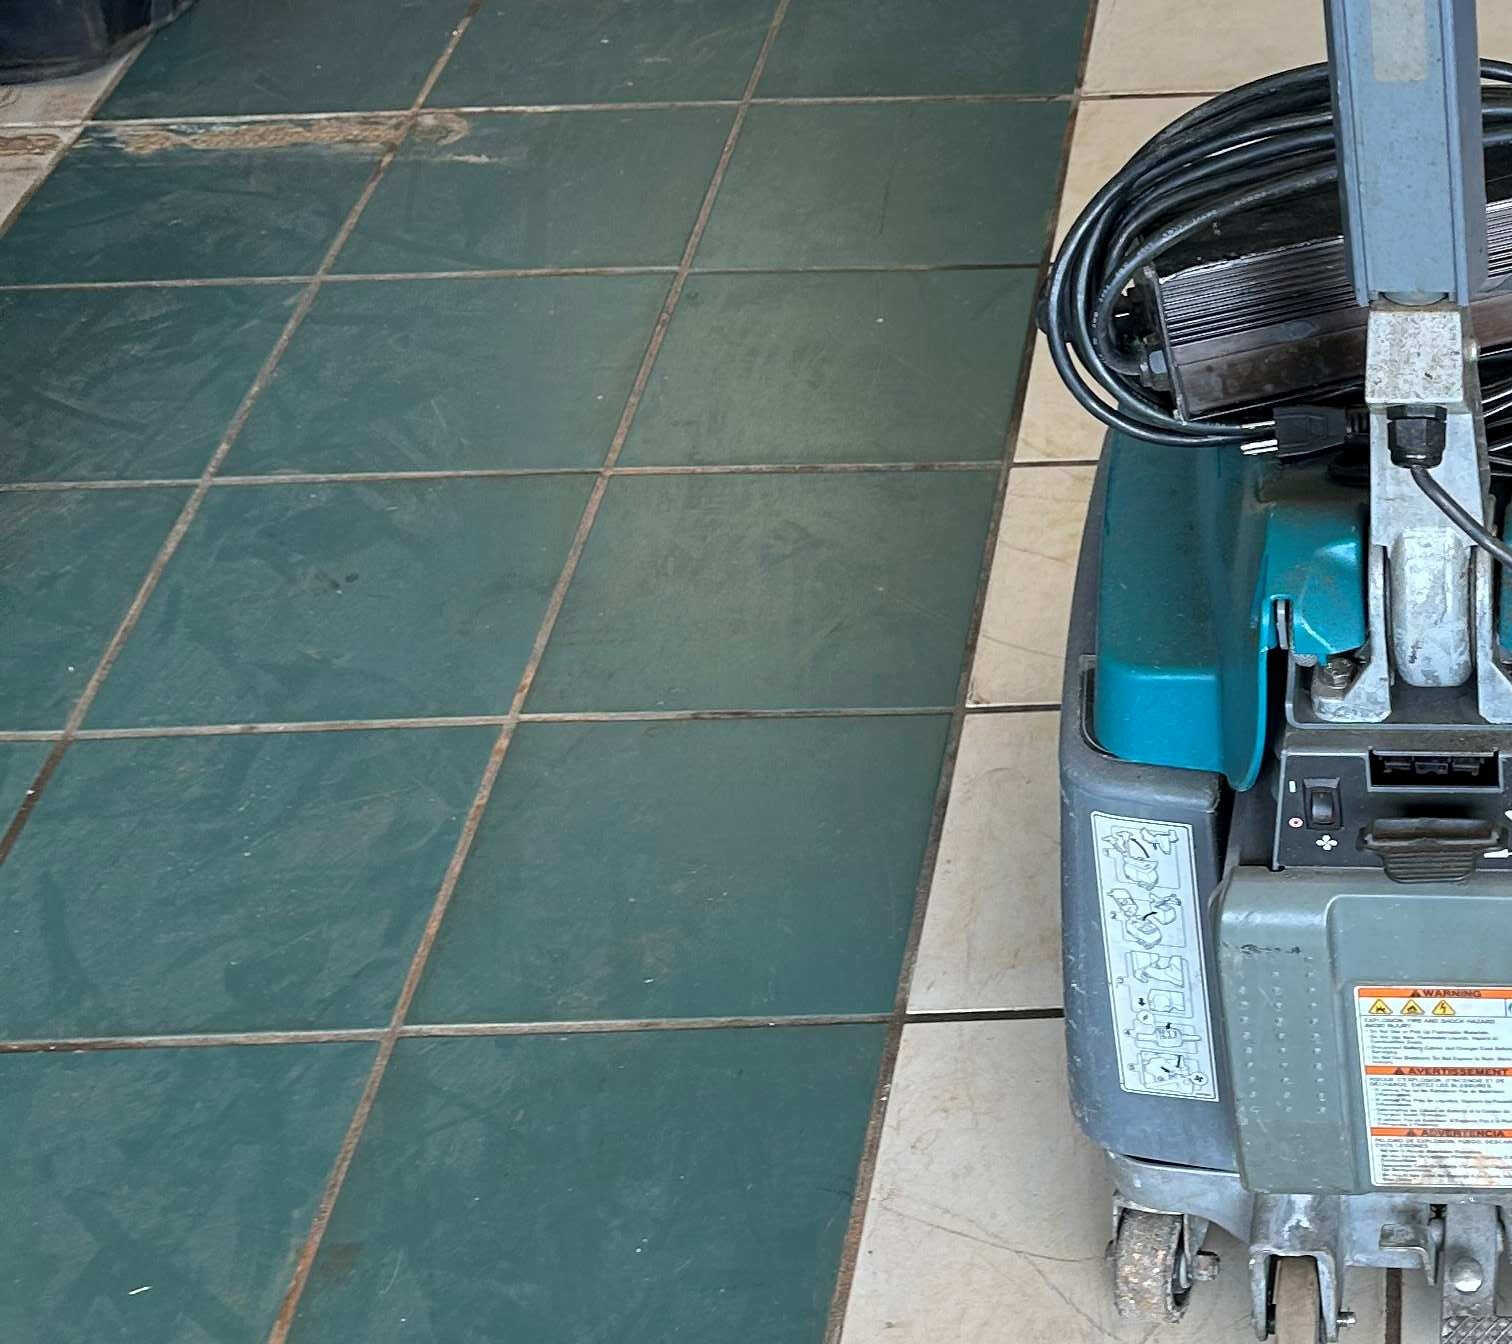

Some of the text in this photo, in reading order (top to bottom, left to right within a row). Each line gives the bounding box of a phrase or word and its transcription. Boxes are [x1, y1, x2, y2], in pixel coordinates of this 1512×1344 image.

[1423, 989, 1482, 998] WARNING
[1408, 1067, 1508, 1076] AVERTISSEMENT
[1421, 1129, 1505, 1138] ADVERTENCIA
